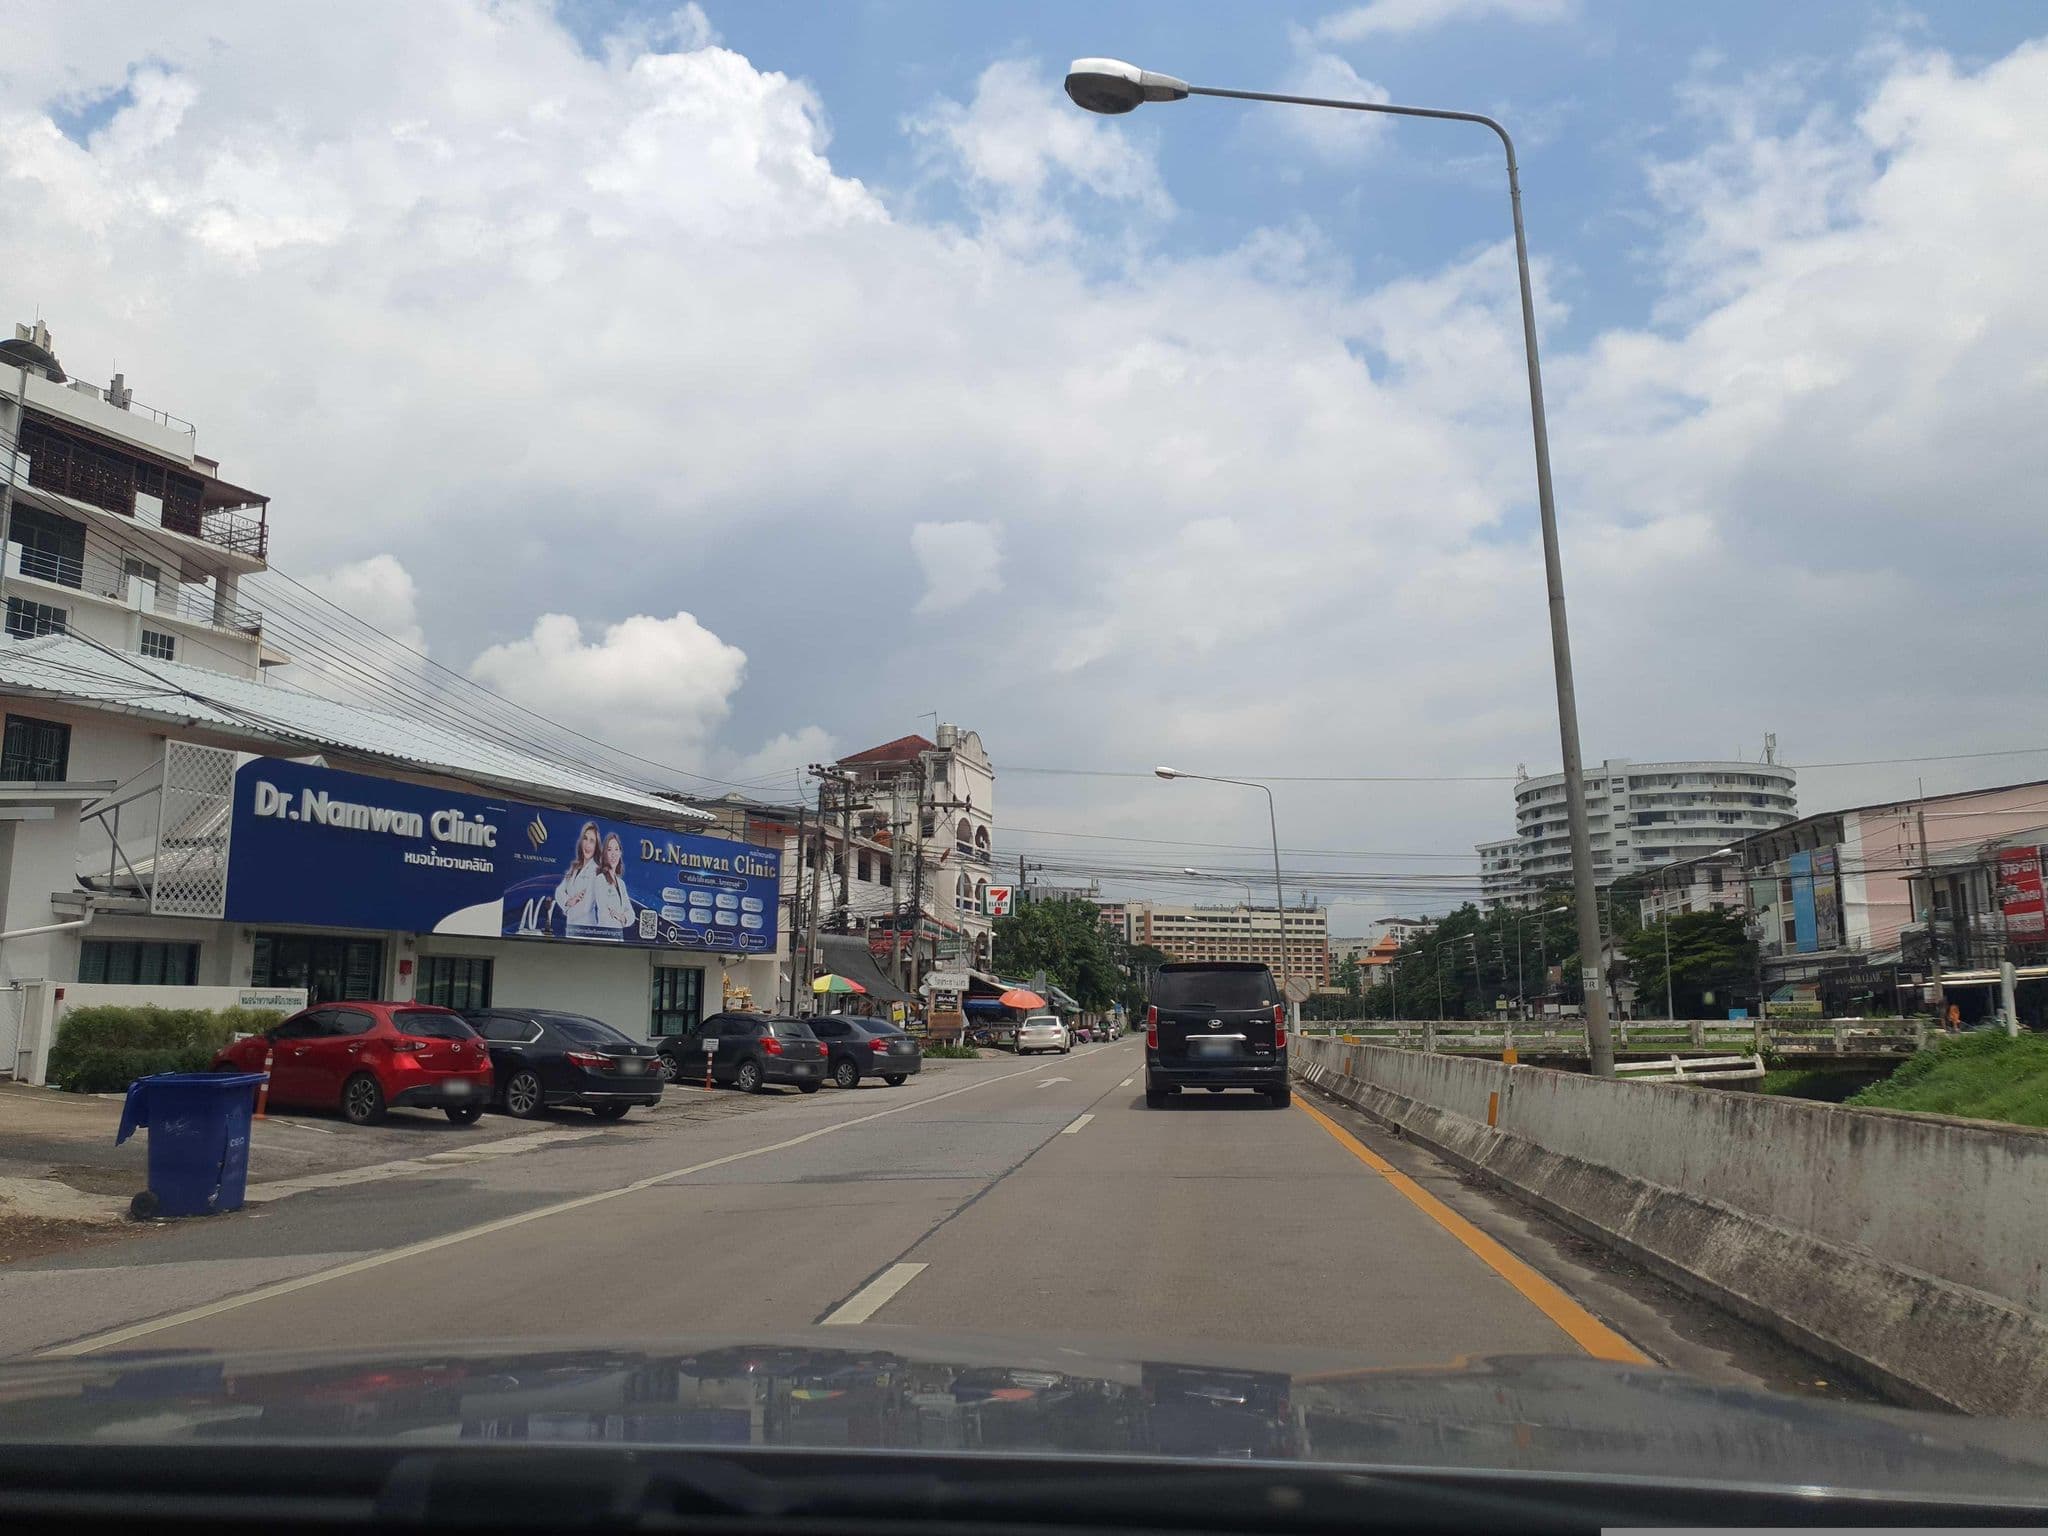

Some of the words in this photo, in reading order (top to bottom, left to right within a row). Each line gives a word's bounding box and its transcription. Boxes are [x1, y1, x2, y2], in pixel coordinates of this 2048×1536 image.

[254, 780, 423, 838] Dr.Namwan
[430, 808, 498, 848] Clinic
[404, 846, 494, 873] หมอน้ำหวานคลินิก
[640, 839, 729, 871] Dr.Namwan
[734, 855, 776, 878] Clinic
[990, 889, 1008, 915] 7
